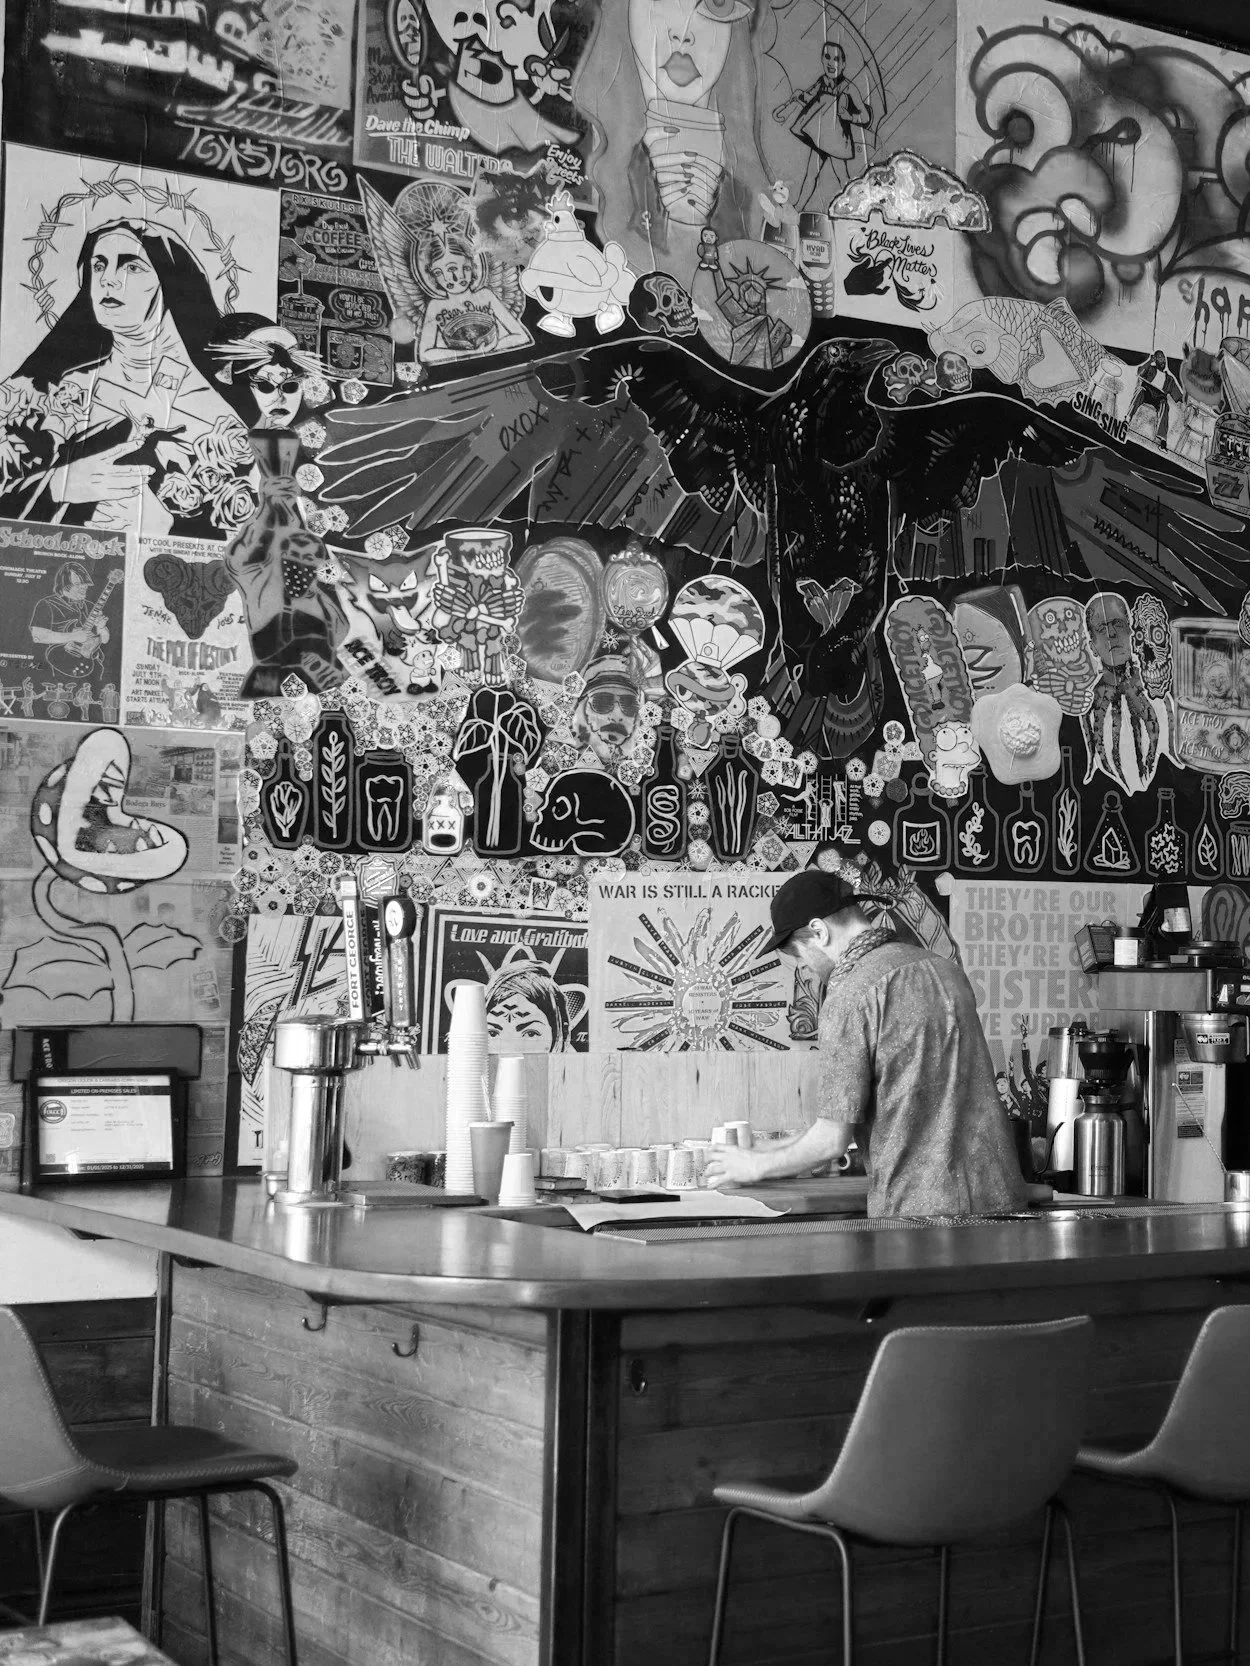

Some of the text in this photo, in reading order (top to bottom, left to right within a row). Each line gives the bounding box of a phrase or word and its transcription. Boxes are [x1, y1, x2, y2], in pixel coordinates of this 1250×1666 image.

[365, 115, 401, 133] Dave
[424, 120, 470, 141] Chimp
[388, 136, 420, 168] THE
[313, 230, 361, 247] COFFEE
[865, 228, 935, 258] Black Lives
[891, 256, 938, 283] Matter
[1073, 391, 1129, 444] SING SING
[599, 884, 782, 899] WAR IS STILL A RACKE
[965, 887, 1117, 913] THEY'RE OUR
[450, 923, 589, 949] Love and Gratitud
[965, 943, 1060, 967] THEY'RE
[967, 969, 1100, 1009] SISTER
